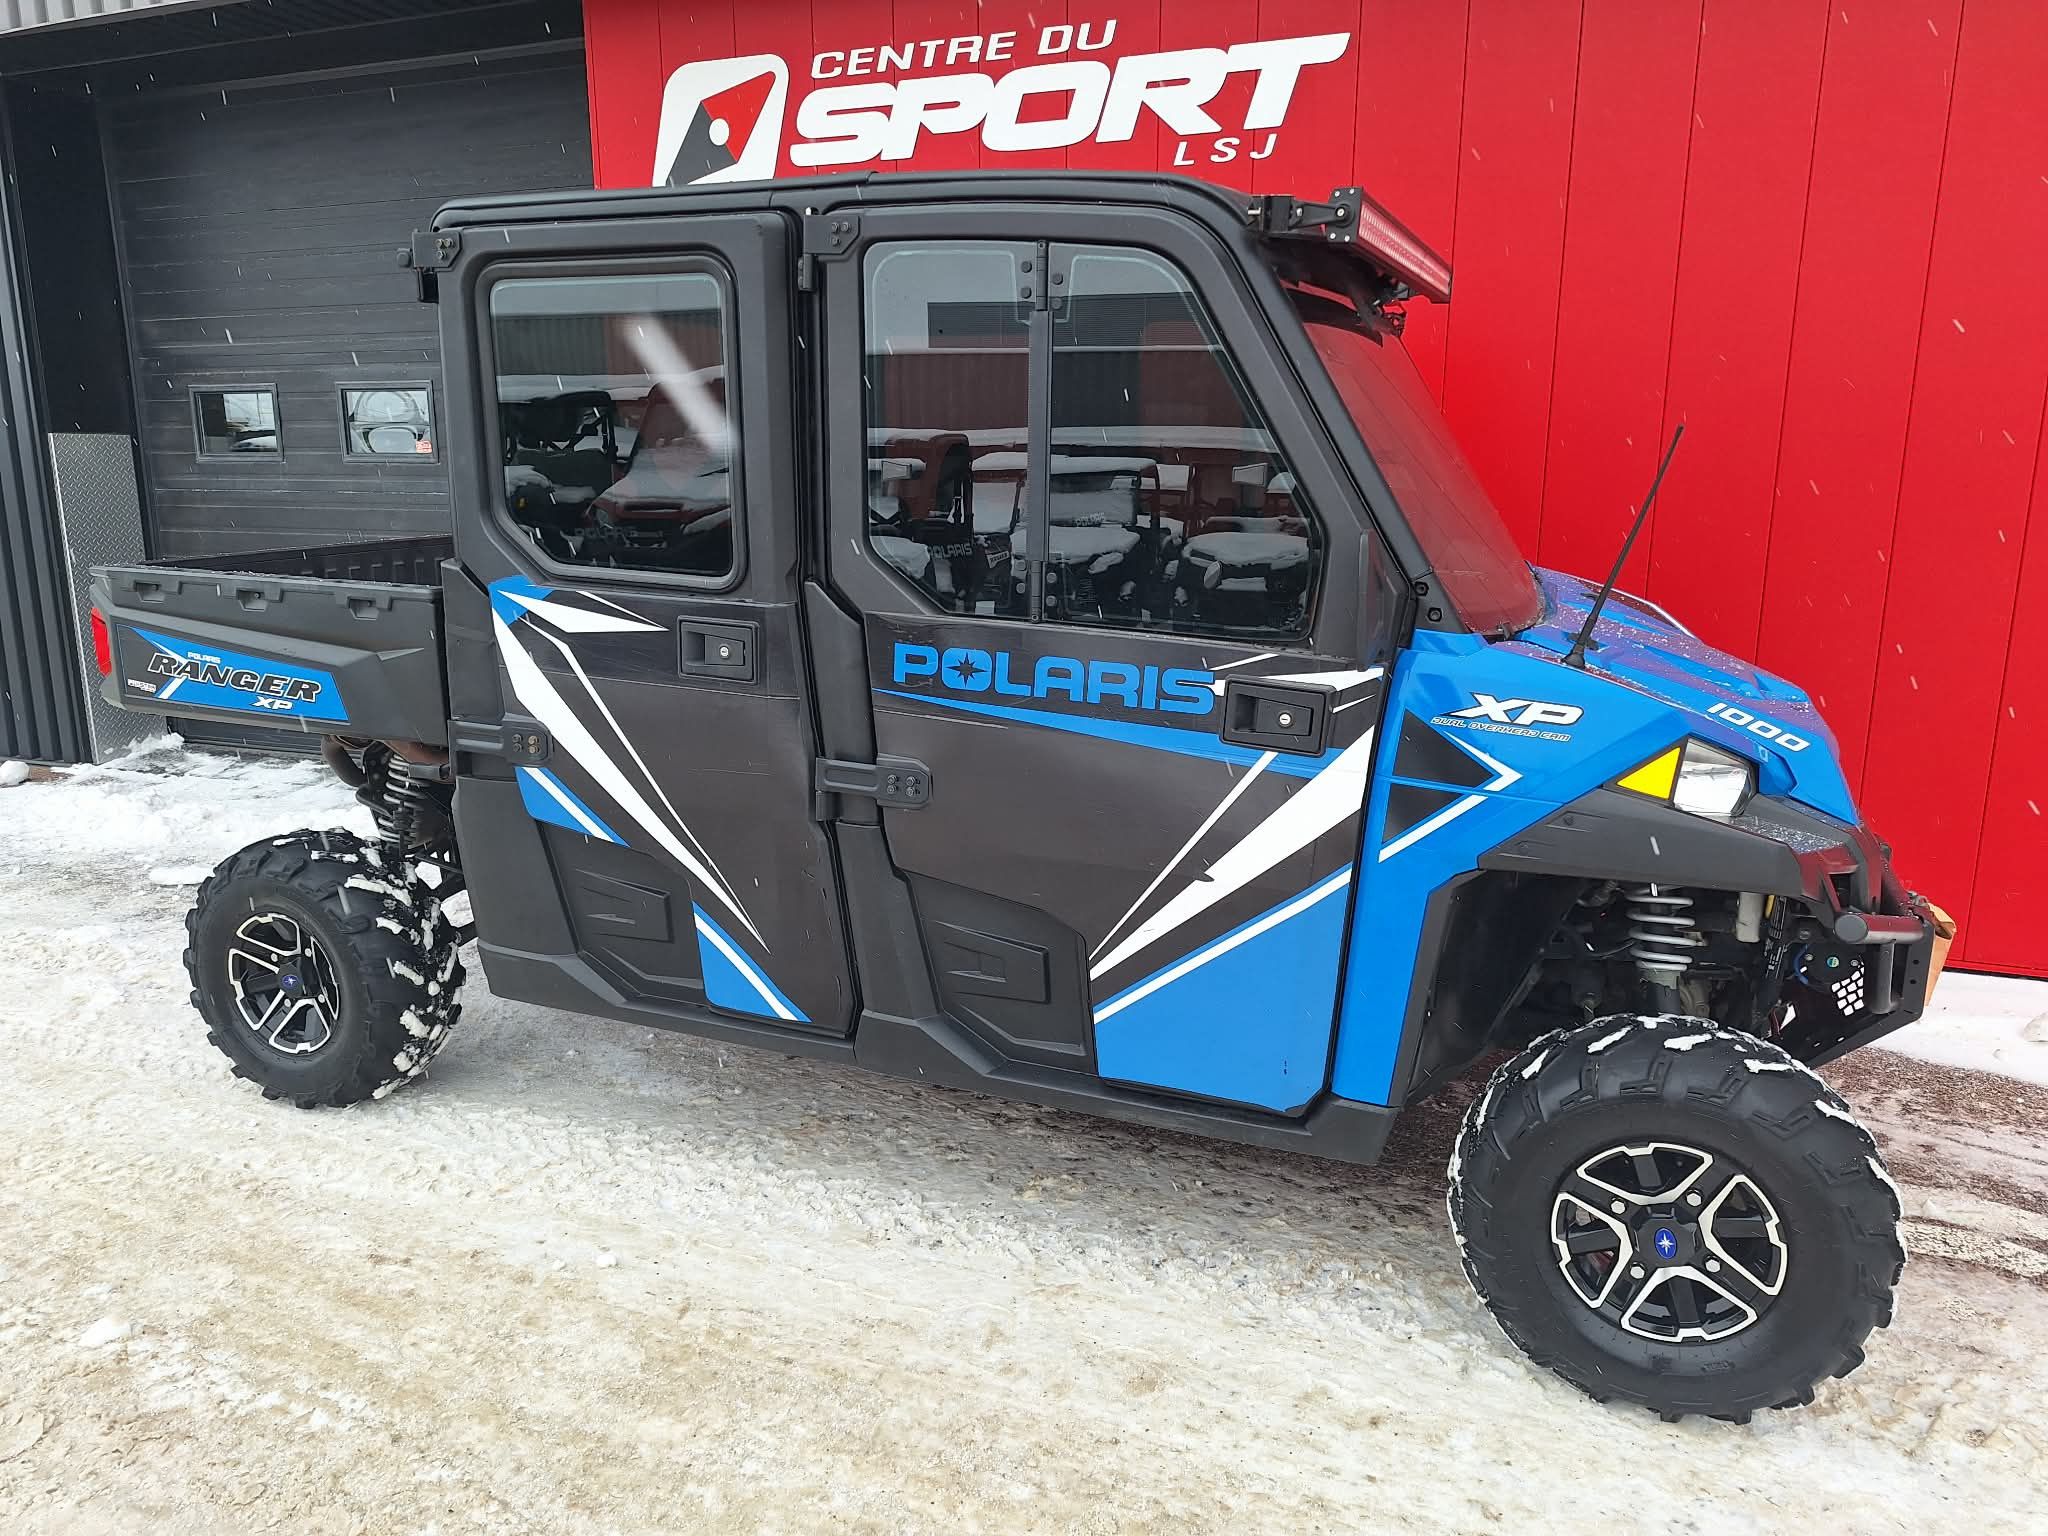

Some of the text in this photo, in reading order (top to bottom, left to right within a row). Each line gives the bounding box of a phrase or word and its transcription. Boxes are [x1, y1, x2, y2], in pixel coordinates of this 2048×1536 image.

[810, 20, 1117, 79] CENTRE DU
[789, 32, 1350, 167] SPORT
[148, 652, 321, 702] RANGER
[187, 652, 221, 663] POLARIS
[892, 641, 1216, 716] POLARIS
[250, 697, 293, 710] XP
[1442, 692, 1584, 726] XP
[1706, 702, 1811, 752] 1000
[1430, 717, 1572, 742] DUAL OVERHEAD CAM
